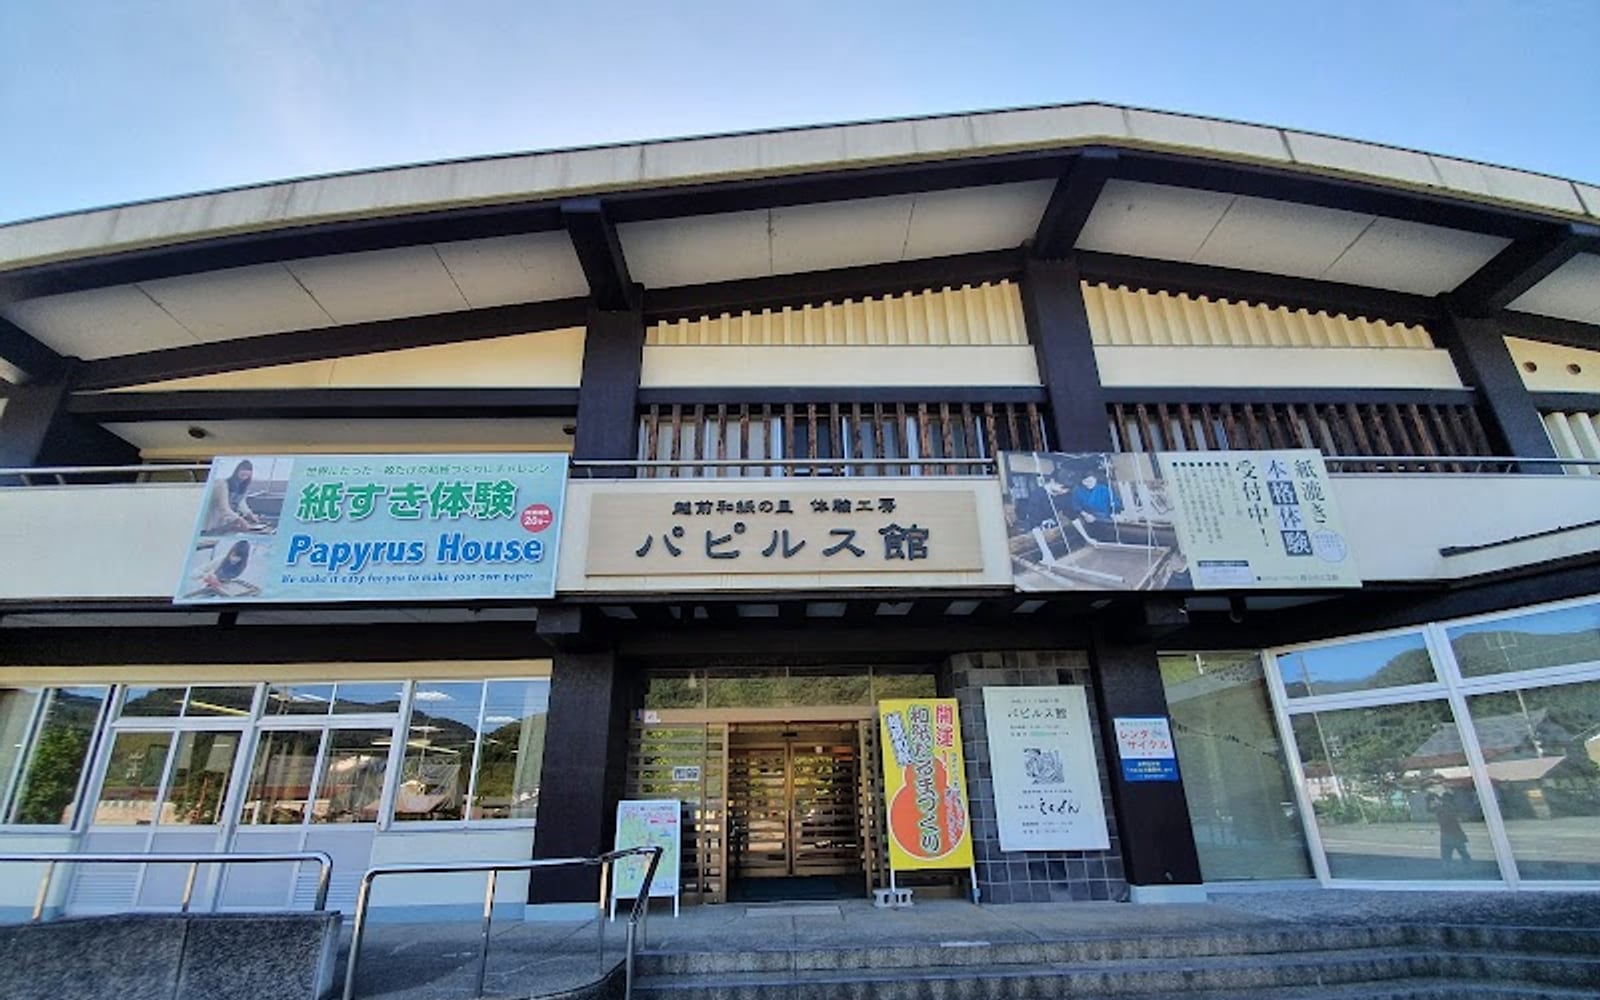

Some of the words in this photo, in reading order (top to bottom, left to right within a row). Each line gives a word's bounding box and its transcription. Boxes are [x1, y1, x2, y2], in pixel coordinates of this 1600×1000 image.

[297, 480, 516, 519] 紙すき体験
[672, 500, 793, 515] 越前和紙の里
[810, 498, 897, 513] 体験工房
[1267, 459, 1312, 555] 本格体験
[1295, 459, 1327, 523] 紙漉き
[287, 535, 424, 571] Papyrus
[437, 532, 543, 563] House
[635, 522, 930, 561] パピルス館
[1008, 707, 1068, 719] パピルス館
